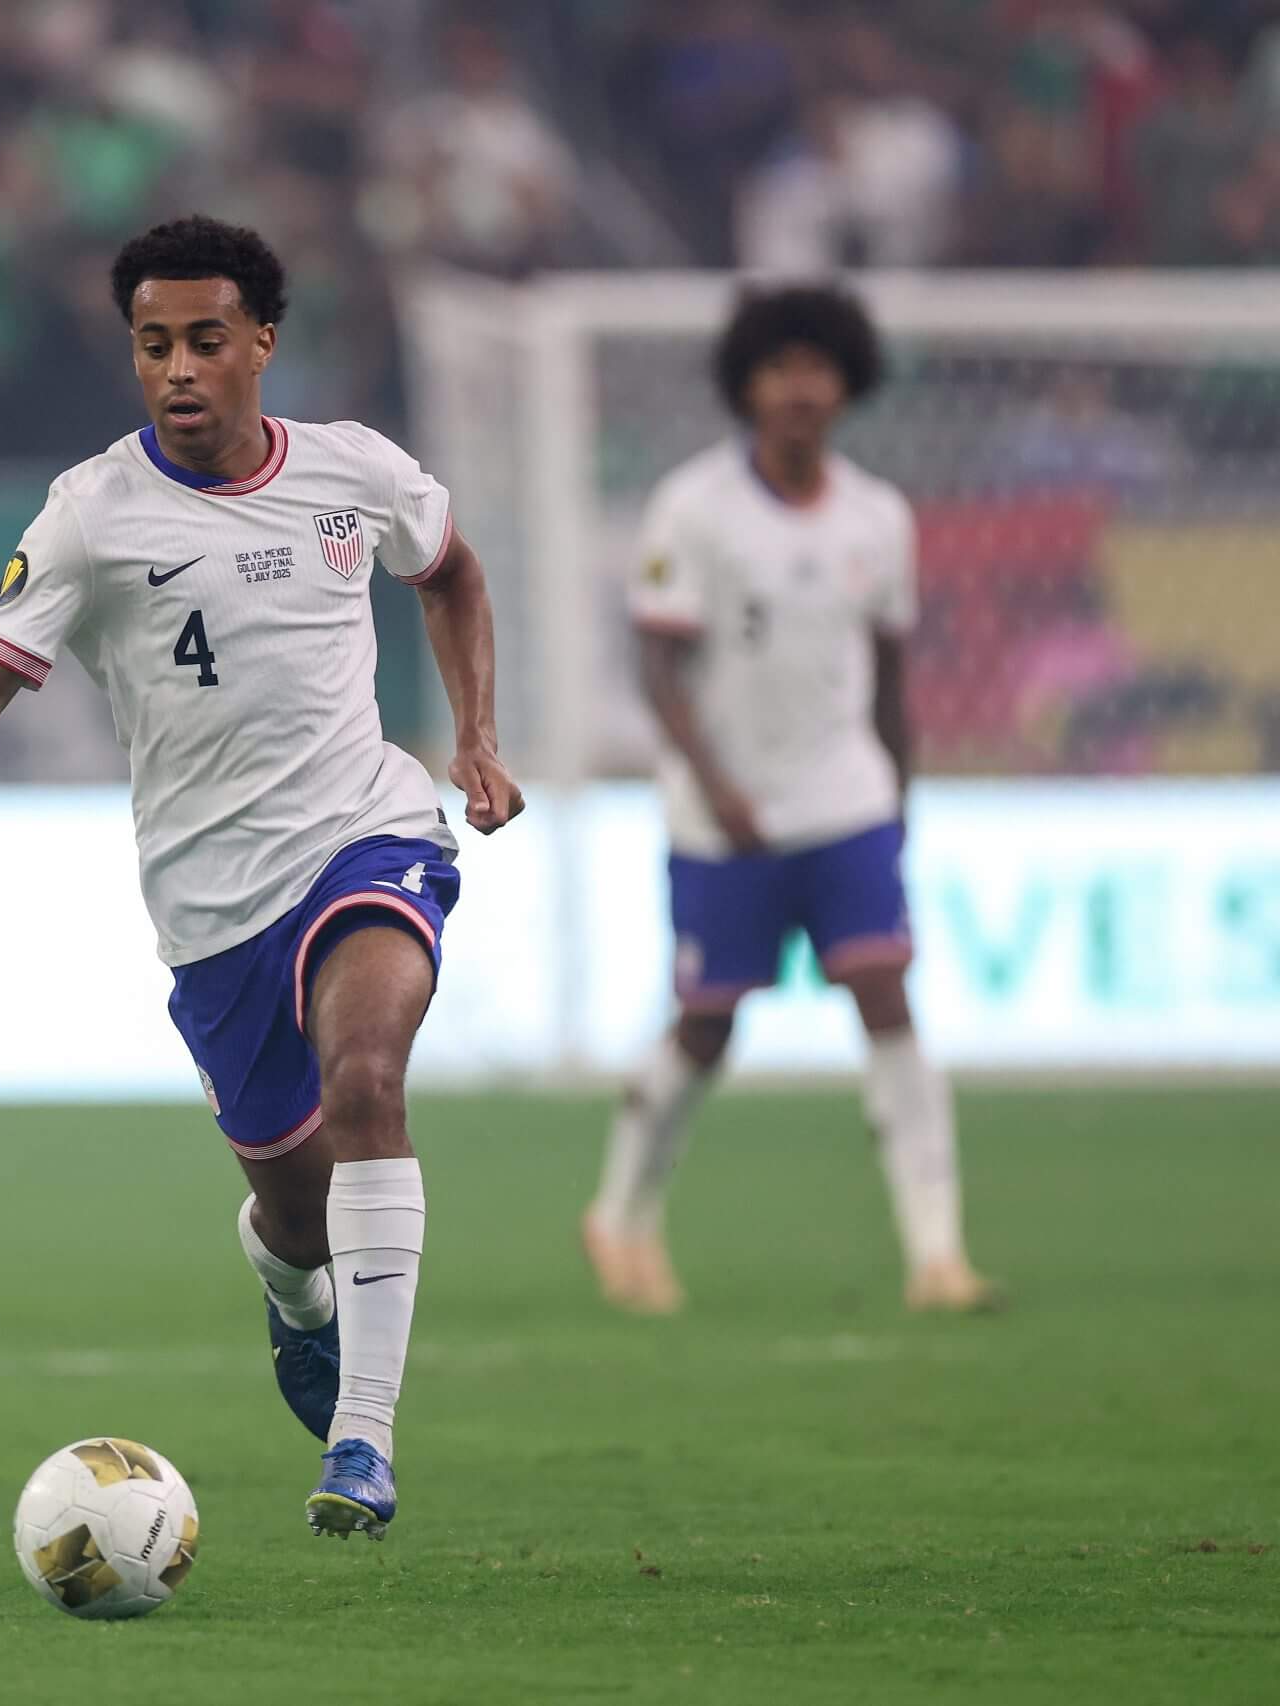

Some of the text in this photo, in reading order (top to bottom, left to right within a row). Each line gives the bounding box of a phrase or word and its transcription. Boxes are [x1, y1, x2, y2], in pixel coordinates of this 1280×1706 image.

[318, 513, 357, 540] USA
[235, 546, 293, 563] USA VS. MEXICO
[237, 557, 296, 574] GOLD CUP FINAL
[246, 568, 291, 583] 6 JULY 2025
[173, 609, 219, 688] 4
[141, 1509, 167, 1560] molten
